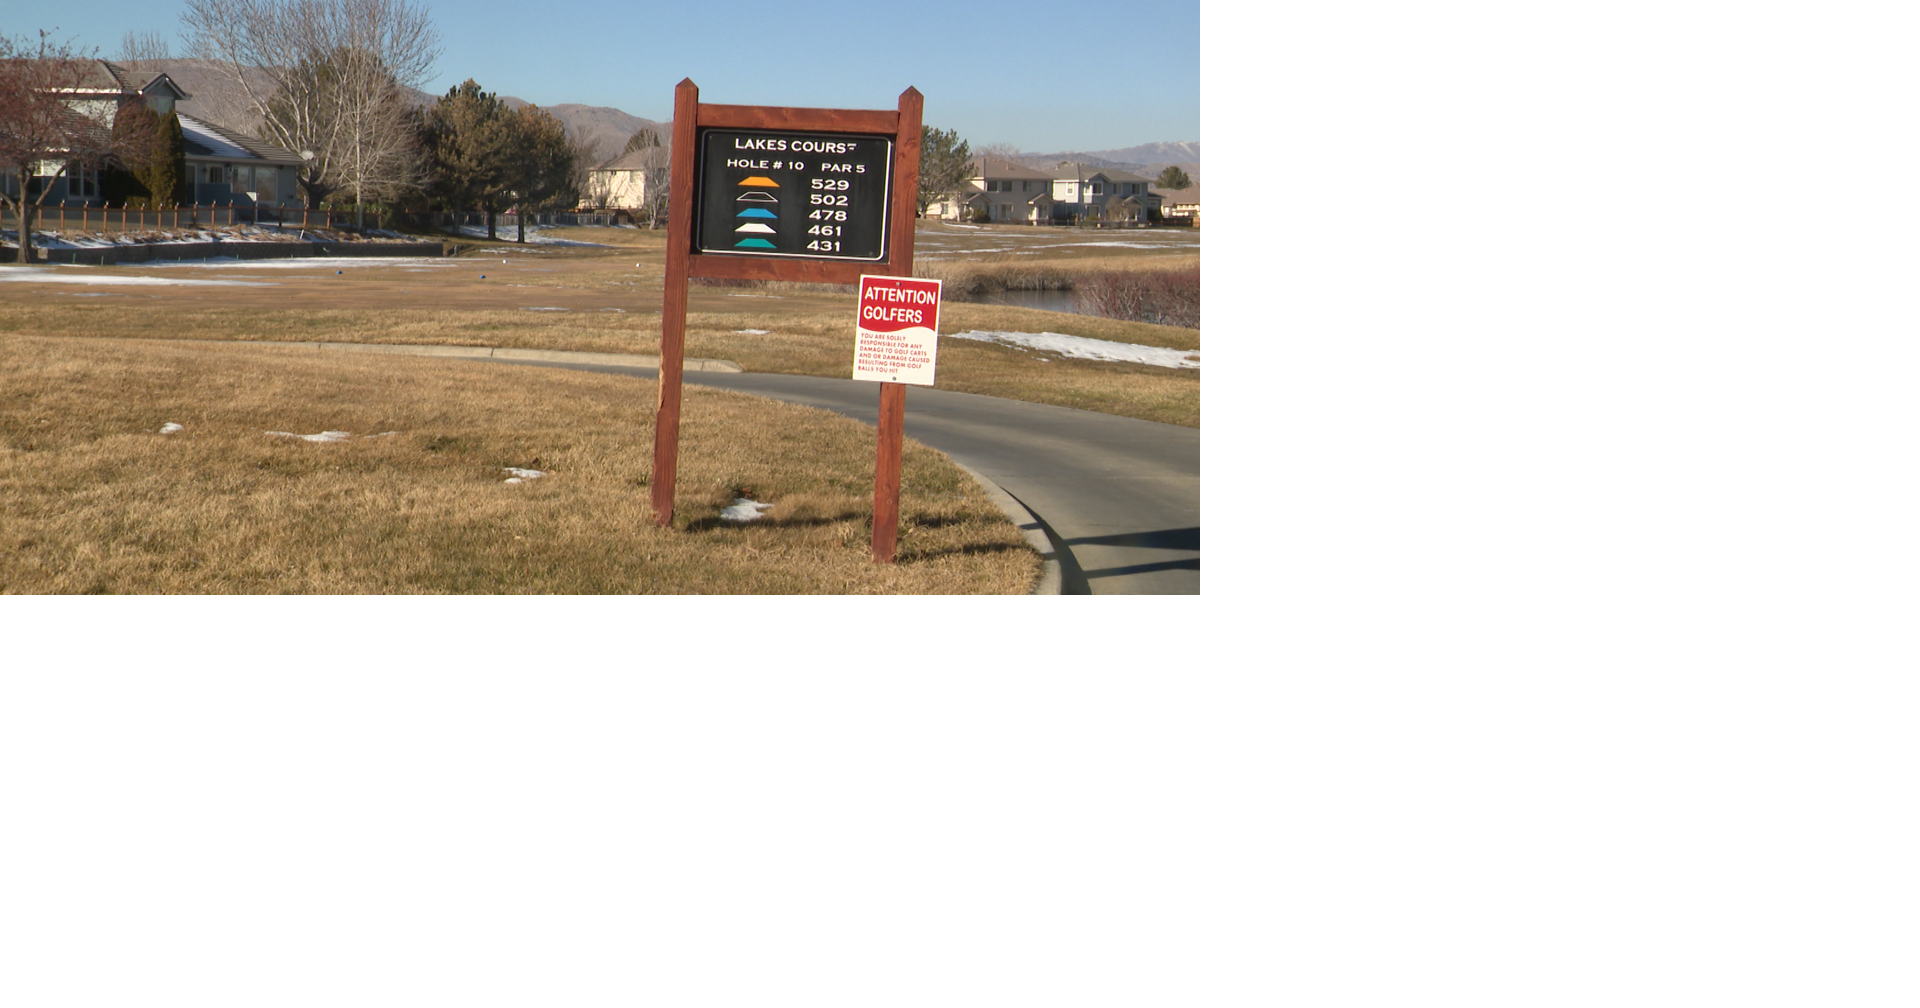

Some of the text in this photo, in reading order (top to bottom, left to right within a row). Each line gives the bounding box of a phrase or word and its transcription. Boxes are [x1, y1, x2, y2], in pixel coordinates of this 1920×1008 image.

[735, 138, 787, 151] LAKES
[727, 159, 804, 170] HOLE # 10
[821, 163, 866, 173] PAR 5
[811, 179, 850, 191] 529
[810, 194, 848, 206] 502
[809, 210, 848, 221] 478
[807, 225, 842, 236] 461
[806, 241, 841, 252] 431
[865, 287, 936, 304] ATTENTION
[863, 306, 923, 323] GOLFERS
